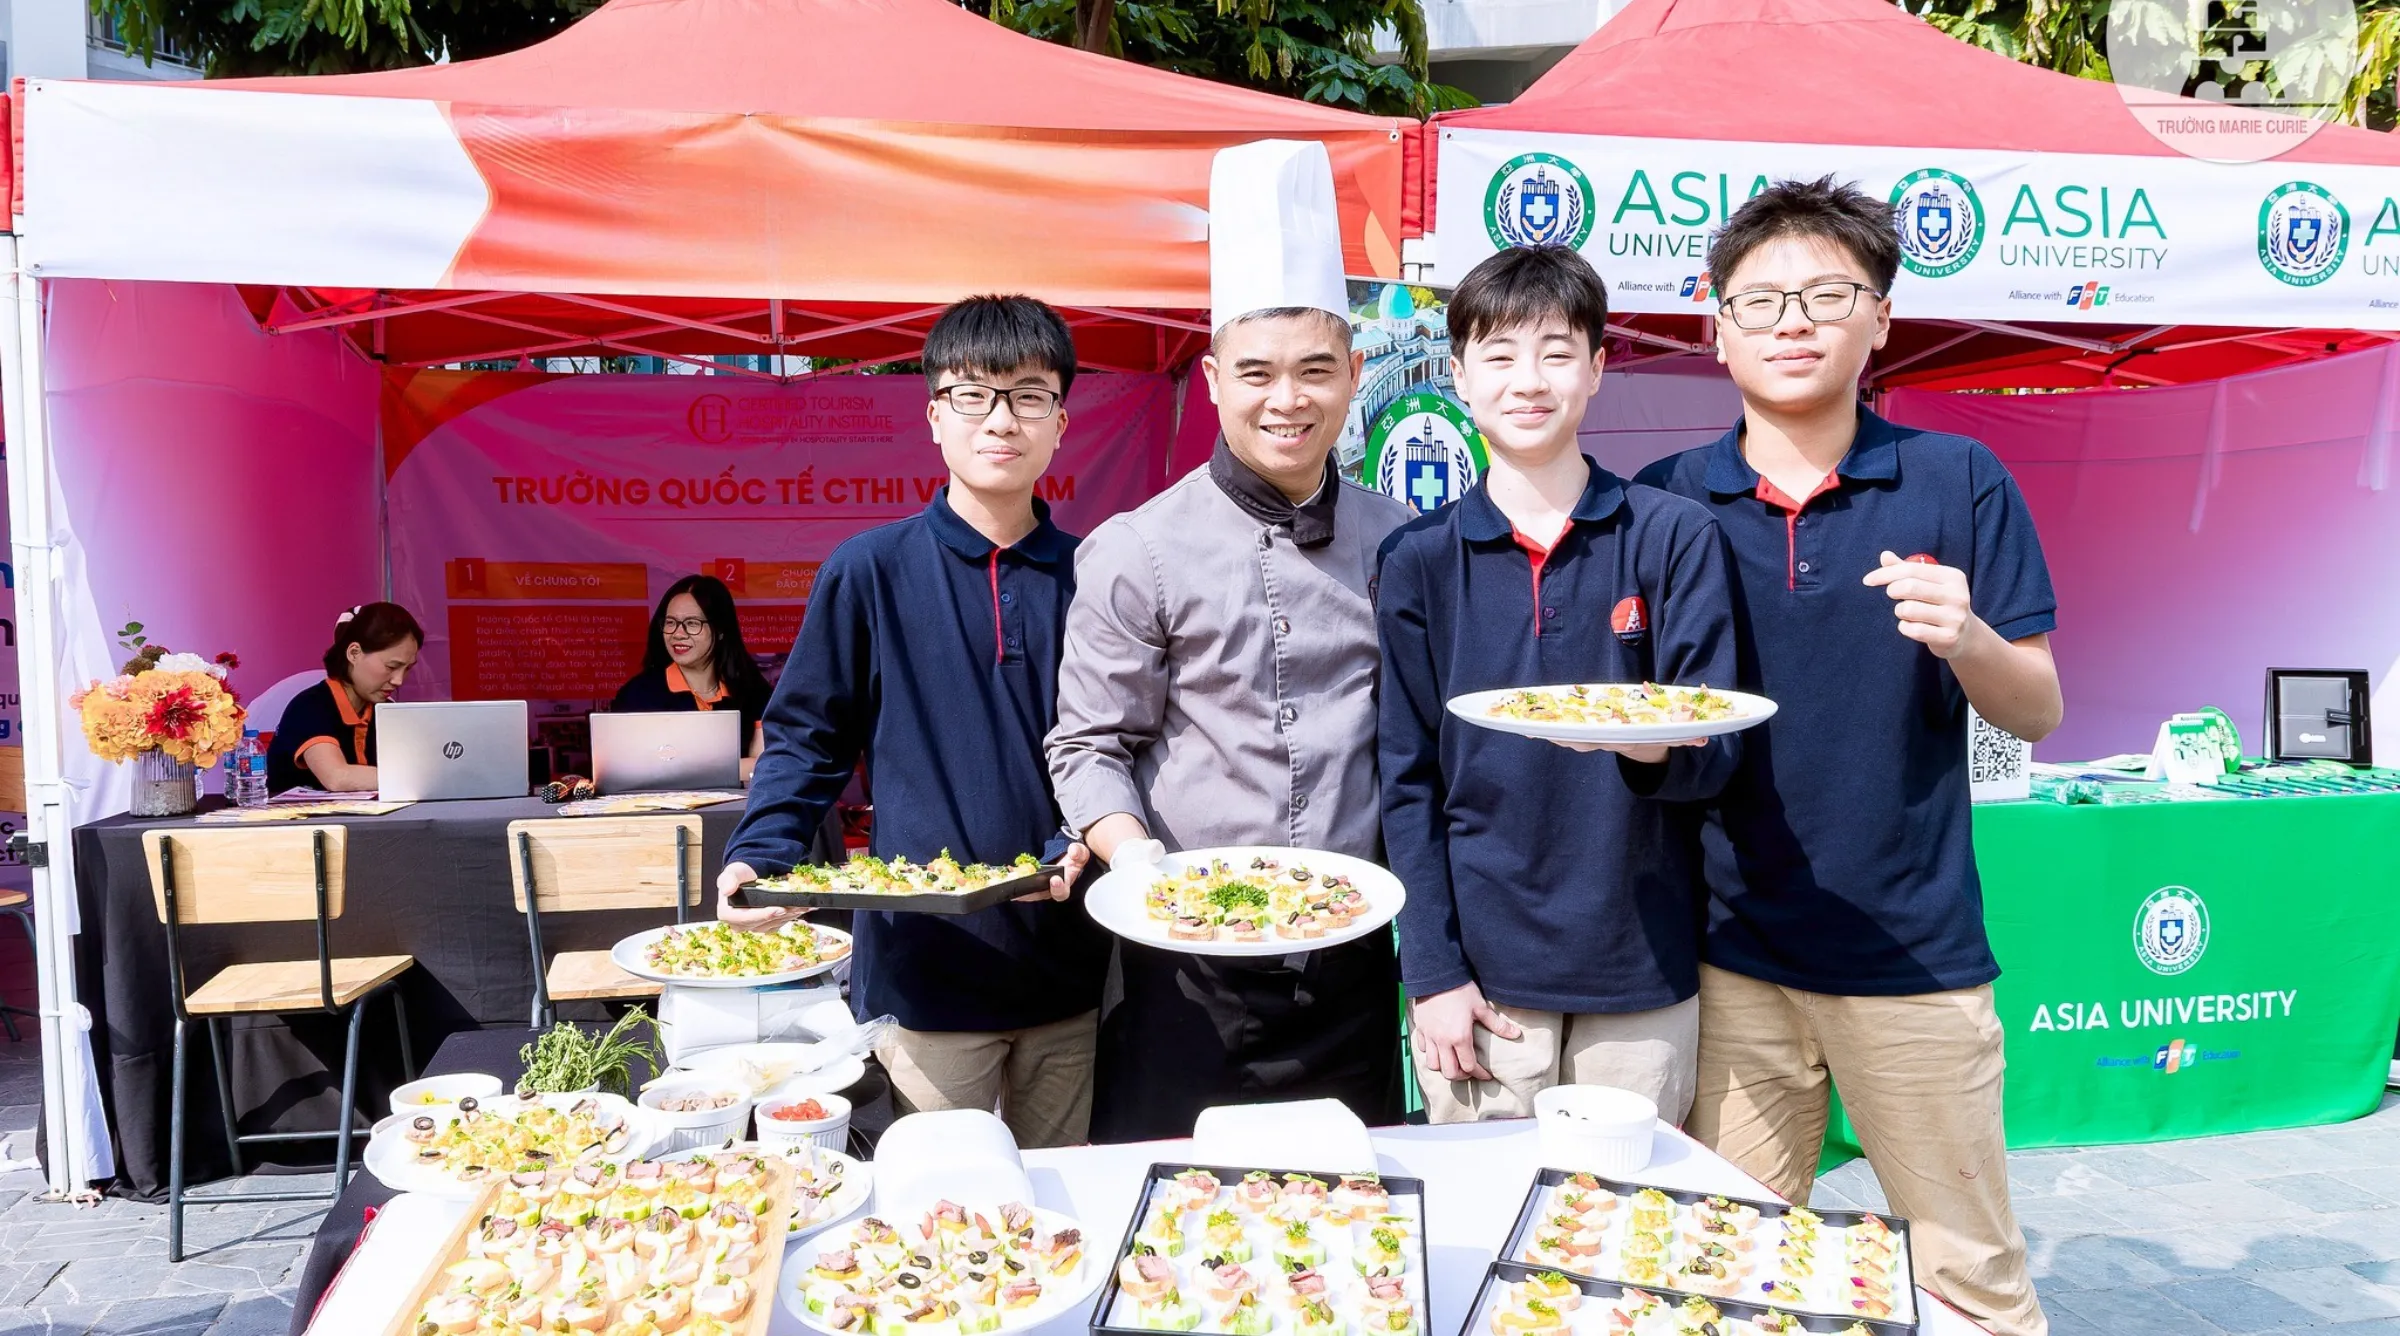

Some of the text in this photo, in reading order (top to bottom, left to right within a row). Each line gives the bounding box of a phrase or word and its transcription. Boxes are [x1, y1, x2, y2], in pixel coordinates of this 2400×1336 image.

[2001, 184, 2168, 240] ASIA
[1609, 233, 1717, 258] UNIVE
[1914, 239, 1980, 276] UNIVERSITY
[2000, 244, 2168, 270] UNIVERSITY
[2283, 249, 2345, 286] UNIVERSITY
[1618, 281, 1653, 292] Alliance
[1656, 281, 1675, 292] with
[2008, 285, 2155, 306] Alliance with FPT Education
[2368, 299, 2399, 309] Alliance
[738, 397, 873, 411] CERTIFIED TOURISM
[738, 415, 894, 429] HOSPITALITY INSTITUTE
[492, 469, 650, 506] TRƯỜNG
[658, 464, 766, 508] QUỐC
[775, 463, 815, 505] TẾ
[823, 477, 904, 504] CTHI
[465, 563, 474, 581] 1
[533, 574, 578, 587] CHÚNG
[725, 563, 735, 581] 2
[443, 741, 464, 761] hp
[2029, 989, 2298, 1032] ASIA UNIVERSITY
